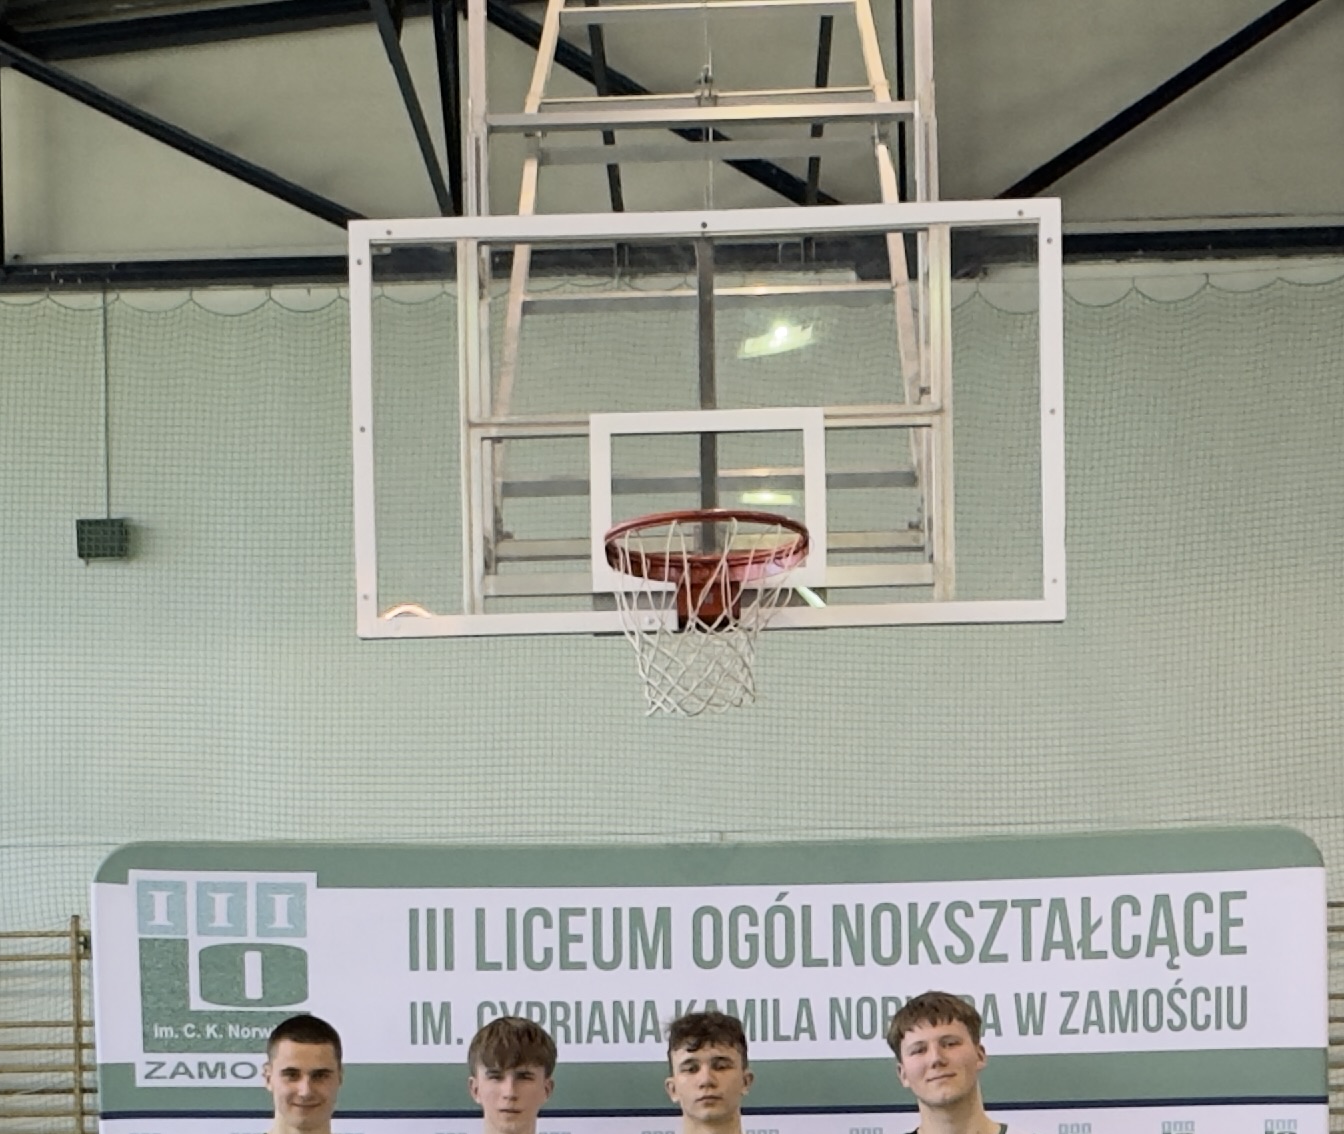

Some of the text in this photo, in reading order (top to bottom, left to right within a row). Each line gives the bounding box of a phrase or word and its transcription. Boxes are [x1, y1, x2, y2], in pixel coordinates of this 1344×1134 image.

[409, 890, 1248, 971] III LICEUM OGÓLNOKSZTAŁCĄCE
[183, 1022, 201, 1039] C.
[206, 1022, 223, 1039] K.
[228, 1022, 277, 1039] Norw
[410, 1000, 464, 1046] IM.
[674, 998, 817, 1042] MILA
[829, 994, 1003, 1041] NORA
[1014, 991, 1047, 1036] W
[1059, 978, 1248, 1036] ZAMOŚCIU
[143, 1061, 260, 1080] ZAMO
